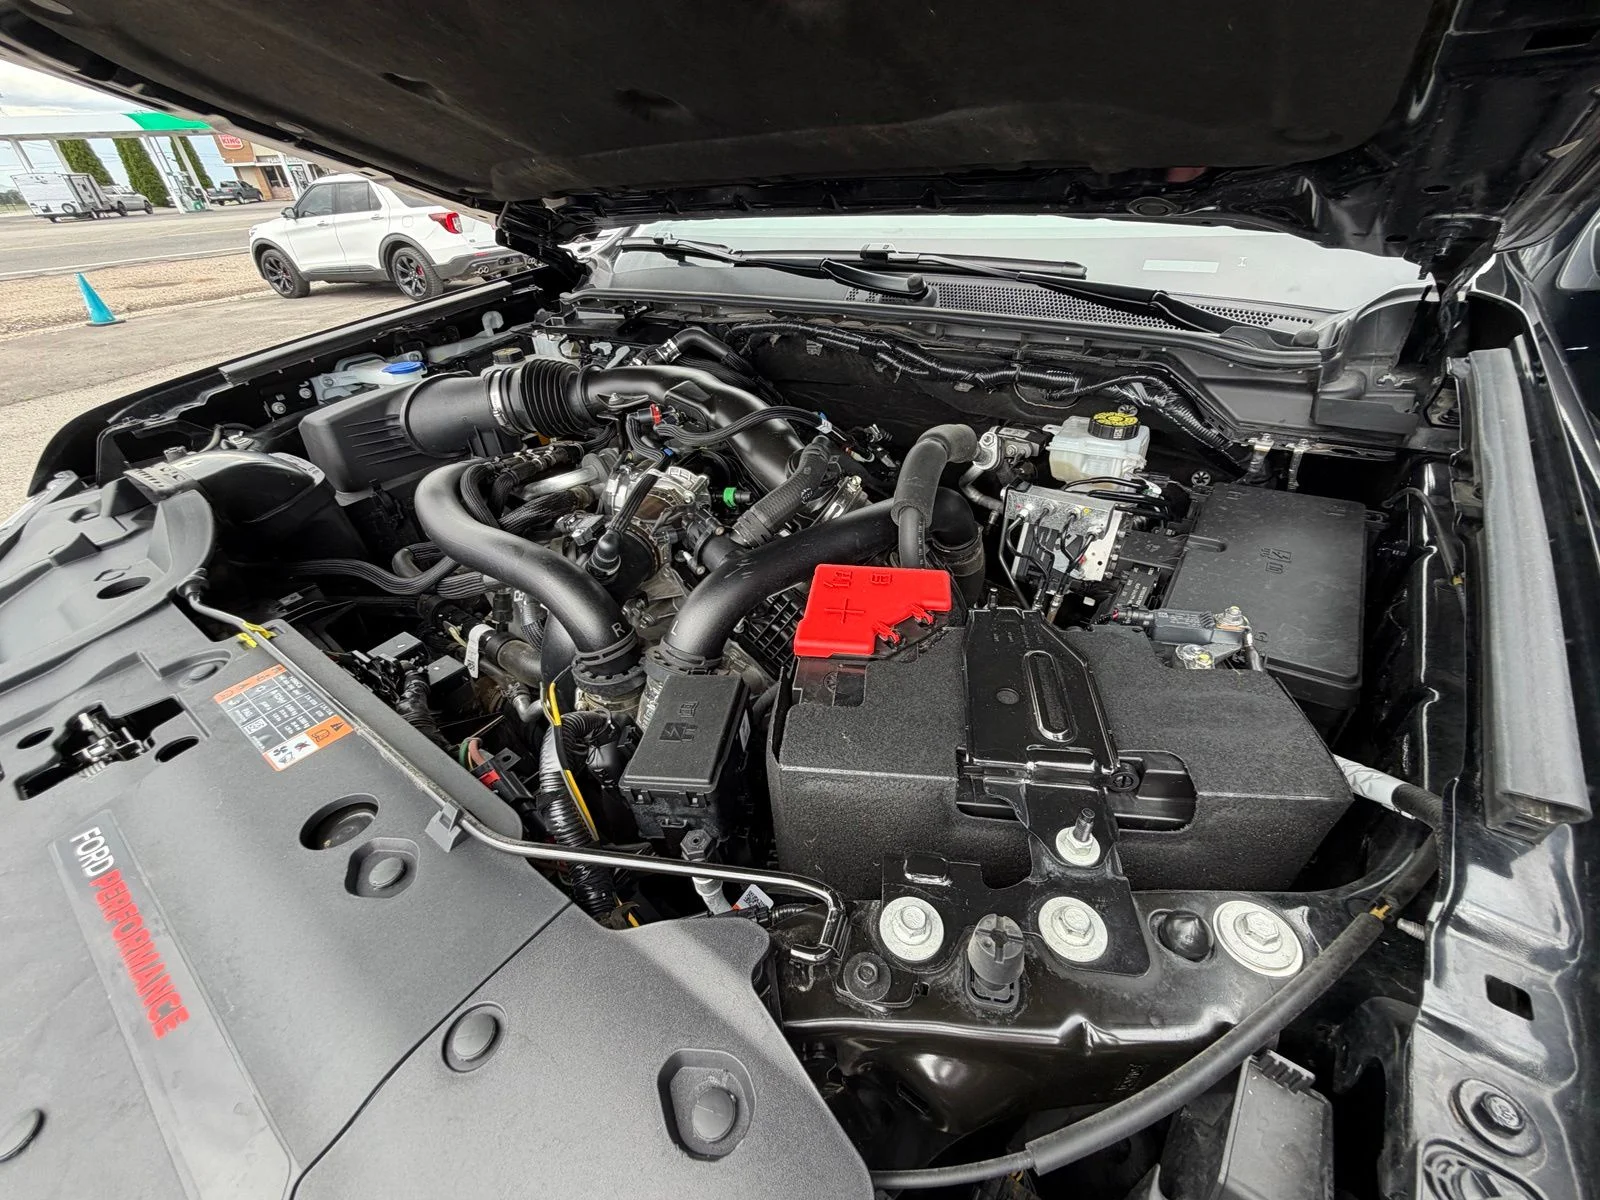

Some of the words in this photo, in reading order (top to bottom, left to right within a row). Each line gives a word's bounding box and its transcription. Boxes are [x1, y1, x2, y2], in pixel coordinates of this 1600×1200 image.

[611, 622, 626, 638] R
[670, 620, 679, 636] L
[69, 826, 115, 878] FORD
[89, 868, 190, 1040] PERFORMANCE
